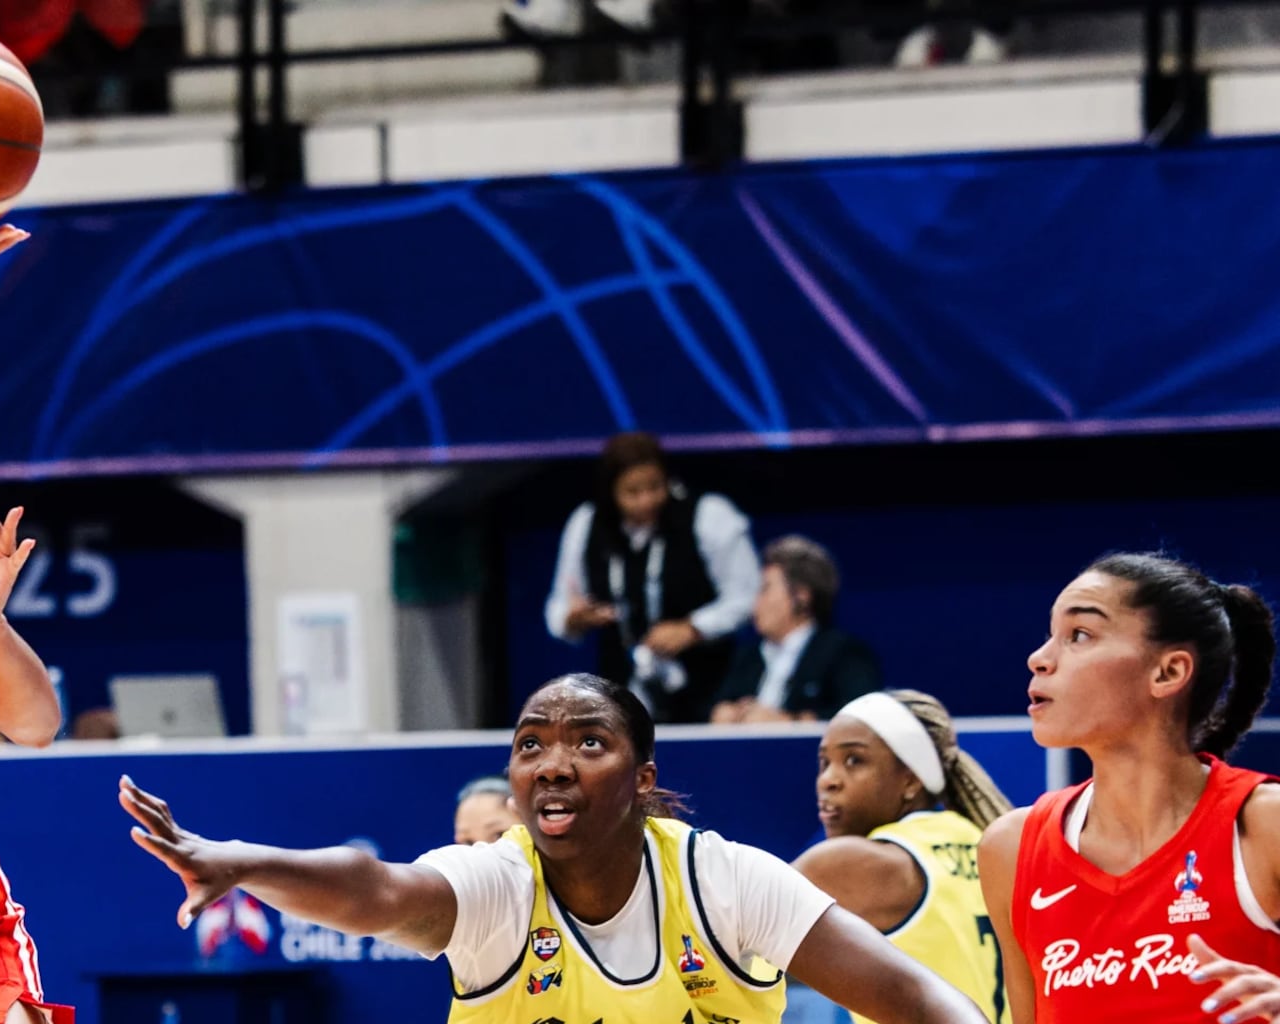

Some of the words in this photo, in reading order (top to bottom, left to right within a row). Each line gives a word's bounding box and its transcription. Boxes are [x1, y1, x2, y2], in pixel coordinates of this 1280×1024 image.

[533, 936, 561, 952] FCB
[1042, 939, 1126, 997] Puerto
[1129, 933, 1200, 990] Rico
